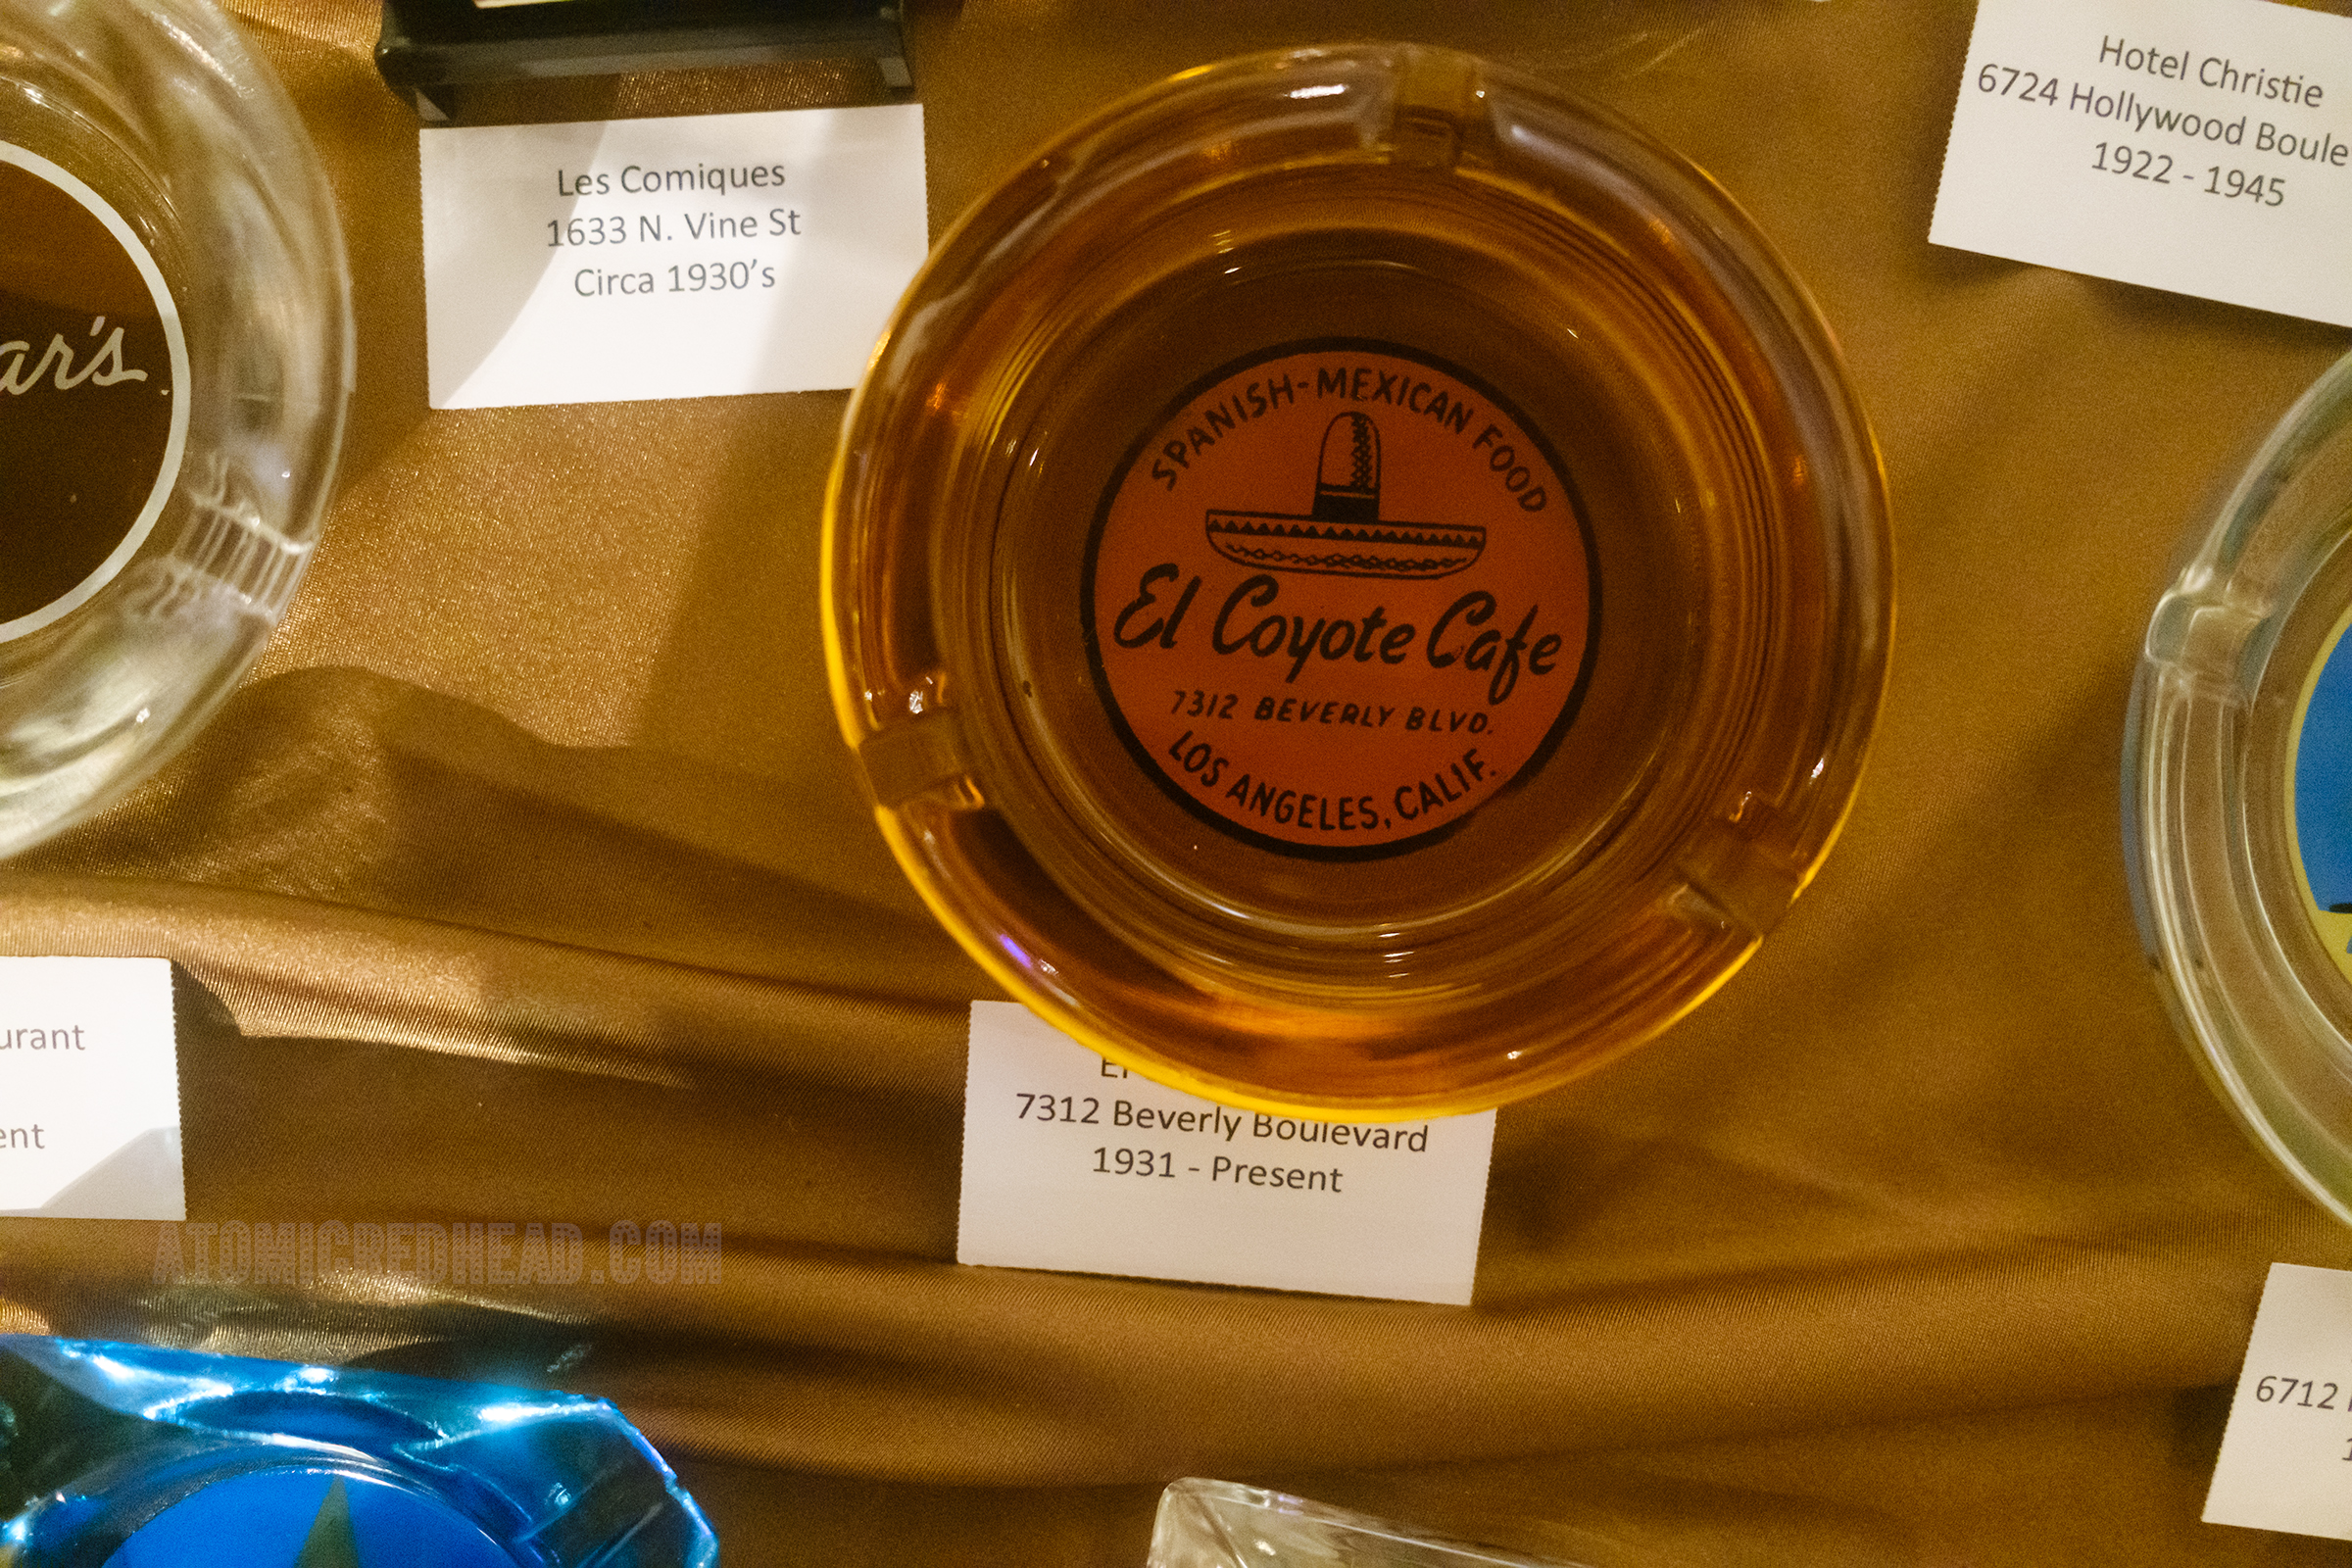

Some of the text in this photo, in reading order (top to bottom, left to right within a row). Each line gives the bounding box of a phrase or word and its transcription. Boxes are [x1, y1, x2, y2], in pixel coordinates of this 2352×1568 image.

[2098, 35, 2324, 108] Hotel Christie
[1977, 63, 2349, 167] 6724 Hollywood Boule
[558, 163, 786, 197] Les Comiques
[2090, 141, 2174, 184] 1922
[2203, 165, 2286, 207] 1945
[547, 208, 802, 247] 1633 N. Vine St
[574, 259, 776, 297] Circa 1930's
[1151, 368, 1548, 513] SPANISH-MEXICAN FOOD
[1112, 563, 1562, 706] El Coyote Cafe
[1170, 690, 1494, 736] 7312 BEVERLY BLVD.
[1167, 729, 1498, 831] LOS ANGELES, CALIF.
[1015, 1092, 1430, 1152] 7312 Beverly Boulevard
[1091, 1146, 1176, 1179] 1931
[1211, 1154, 1345, 1193] Present
[2255, 1375, 2339, 1410] 6712
